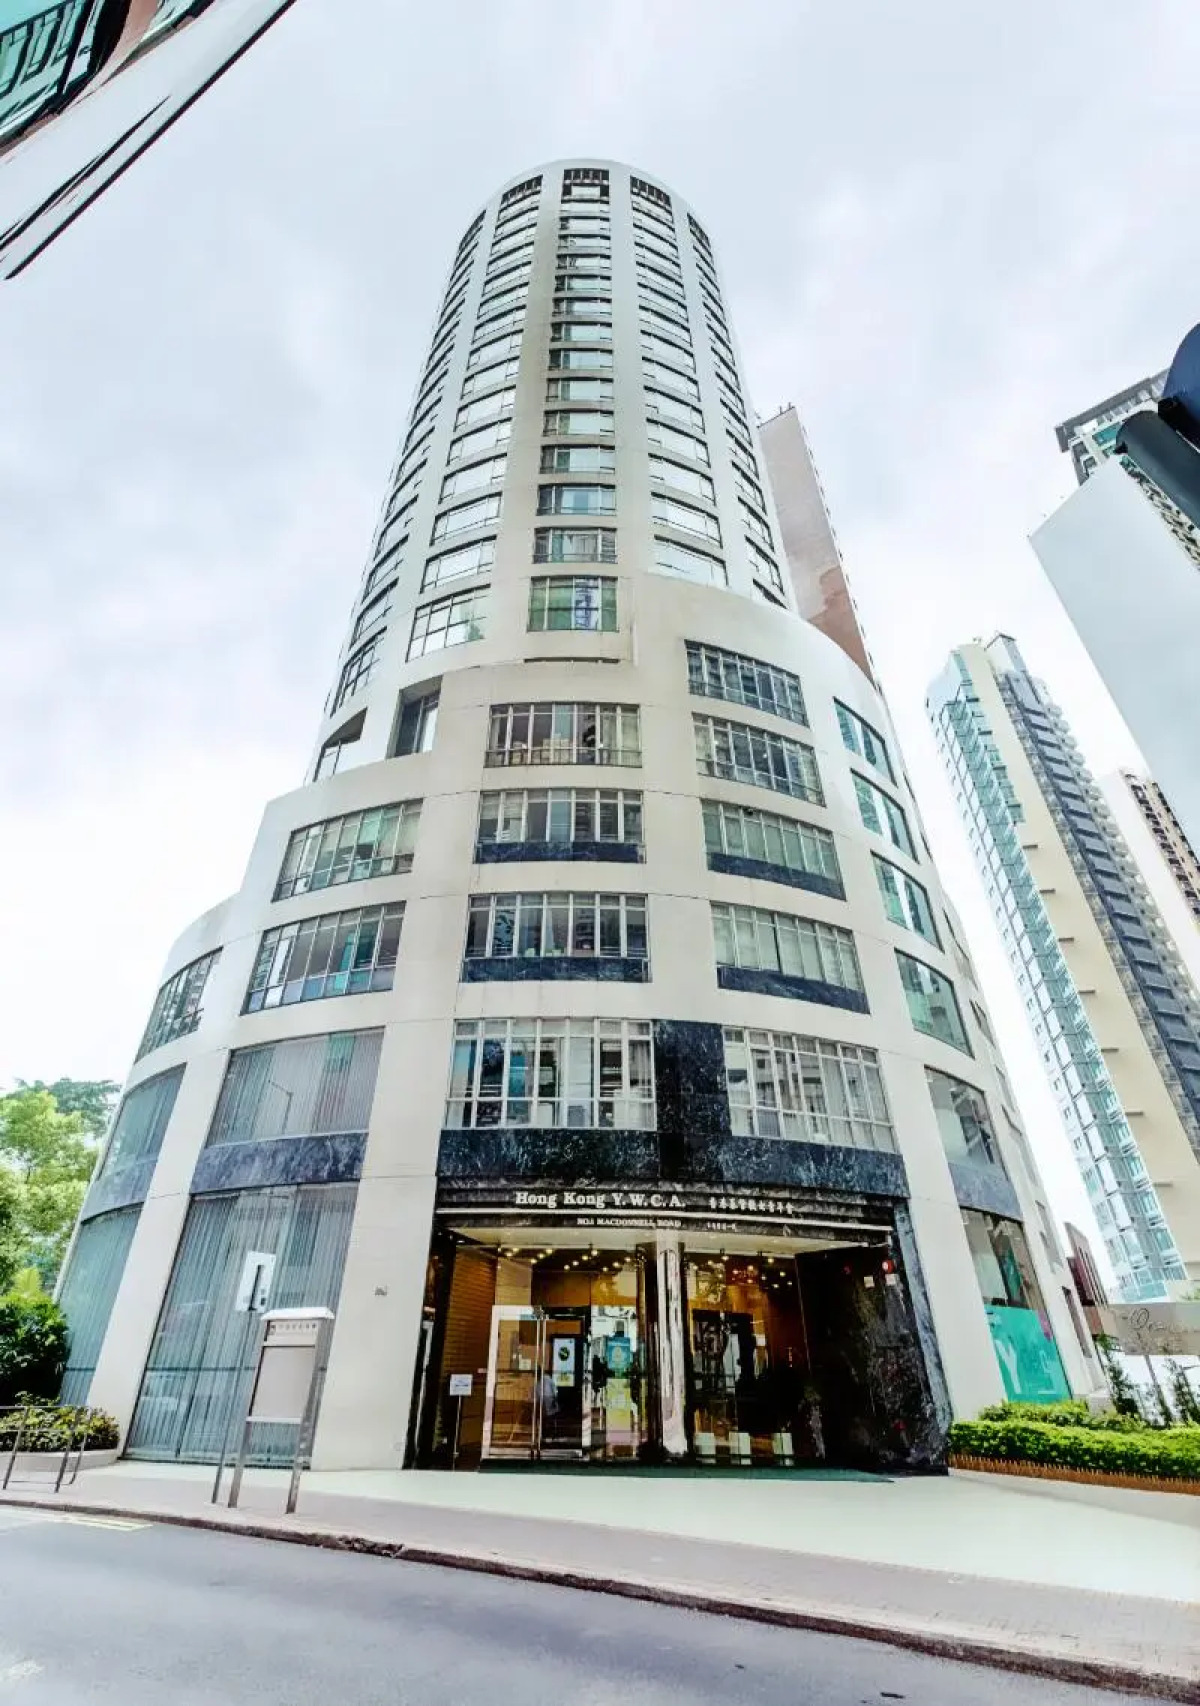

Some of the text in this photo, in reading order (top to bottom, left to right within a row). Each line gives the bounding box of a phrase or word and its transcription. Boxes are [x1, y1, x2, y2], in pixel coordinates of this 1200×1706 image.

[515, 1191, 686, 1209] Hong Kong Y.W.C.A.
